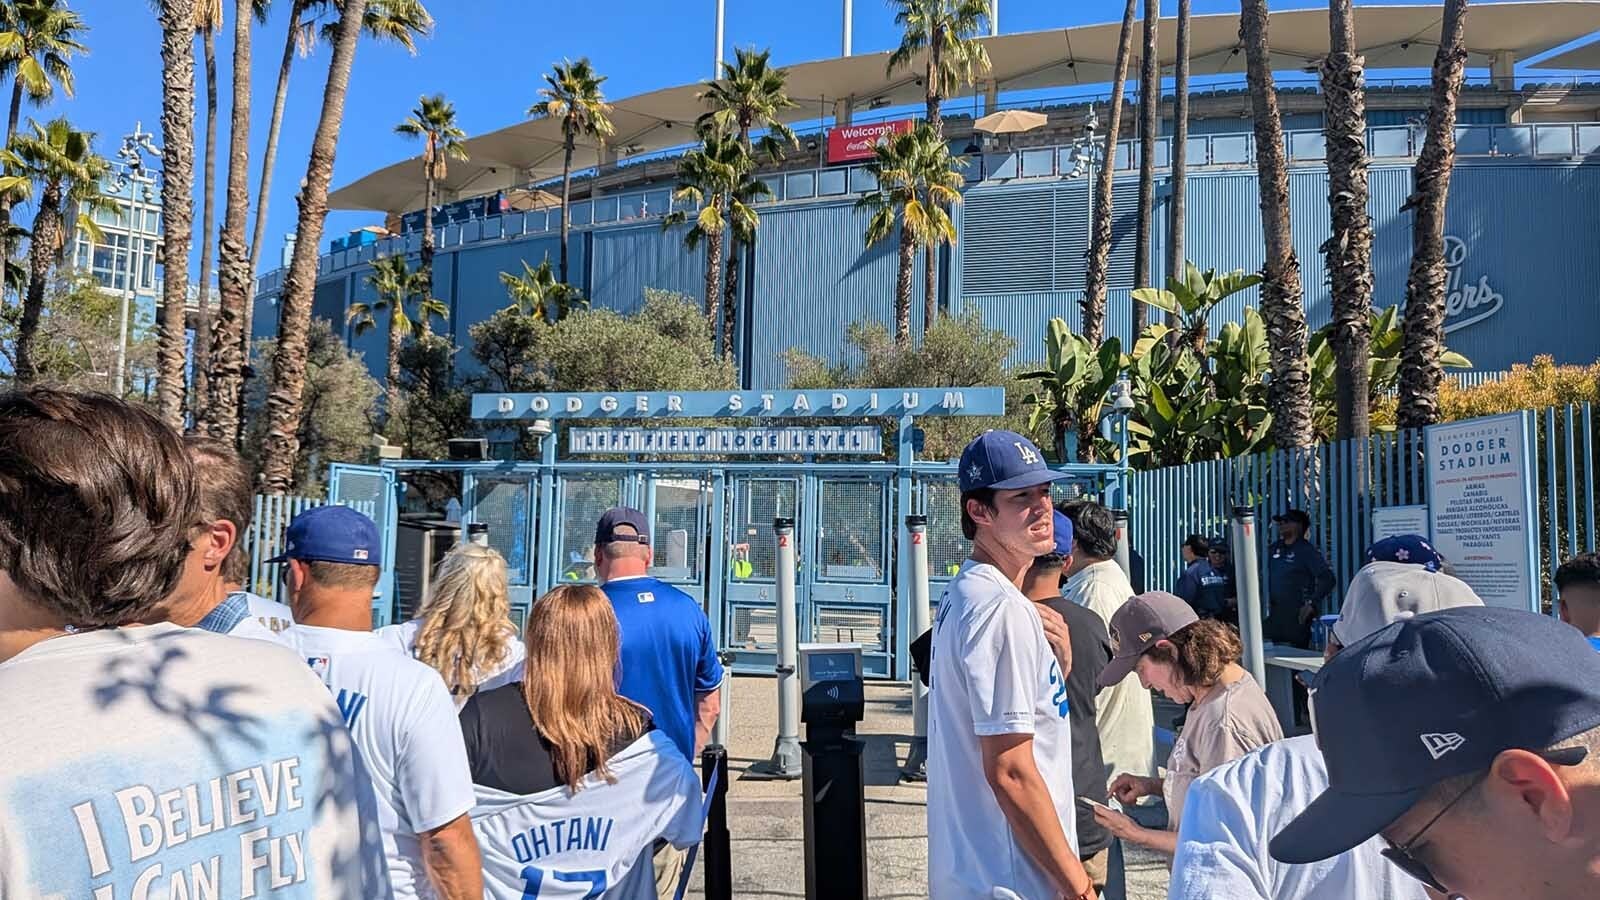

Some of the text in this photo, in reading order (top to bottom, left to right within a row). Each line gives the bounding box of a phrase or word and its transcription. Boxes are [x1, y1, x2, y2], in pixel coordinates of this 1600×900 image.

[498, 391, 965, 413] DODGER STADIUM
[586, 433, 860, 446] LEFT FIELD LOGE LEVEL
[1441, 437, 1506, 456] DODGER
[1013, 441, 1040, 465] LA
[1439, 452, 1511, 471] STADIUM
[1465, 482, 1485, 490] ARMAS
[778, 535, 788, 548] 2
[911, 534, 921, 545] 2
[72, 800, 112, 879] I
[512, 816, 614, 864] OHTANI
